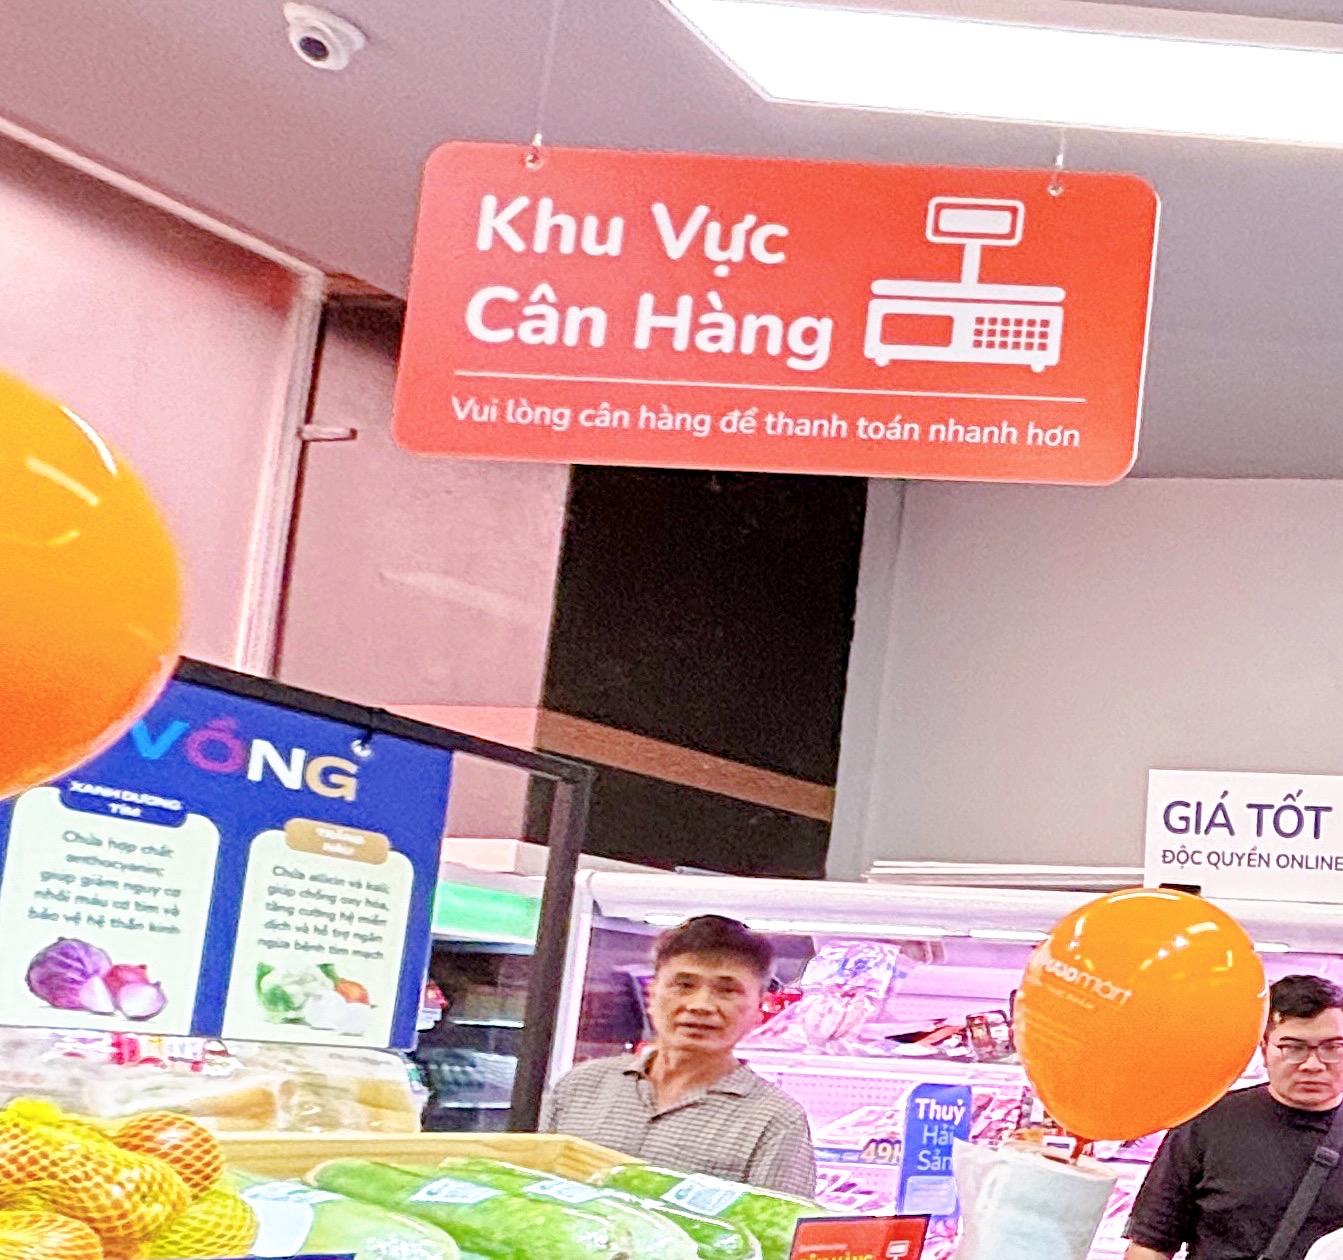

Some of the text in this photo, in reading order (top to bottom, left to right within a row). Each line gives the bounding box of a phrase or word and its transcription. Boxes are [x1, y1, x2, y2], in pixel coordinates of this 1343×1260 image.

[477, 194, 789, 277] Khu Vực
[465, 283, 833, 371] Cân Hàng
[452, 396, 1081, 447] Vui lòng cân hàng để thanh toán nhanh hơn
[1163, 789, 1333, 840] GIÁ TỐT
[1162, 845, 1203, 869] ĐỘC
